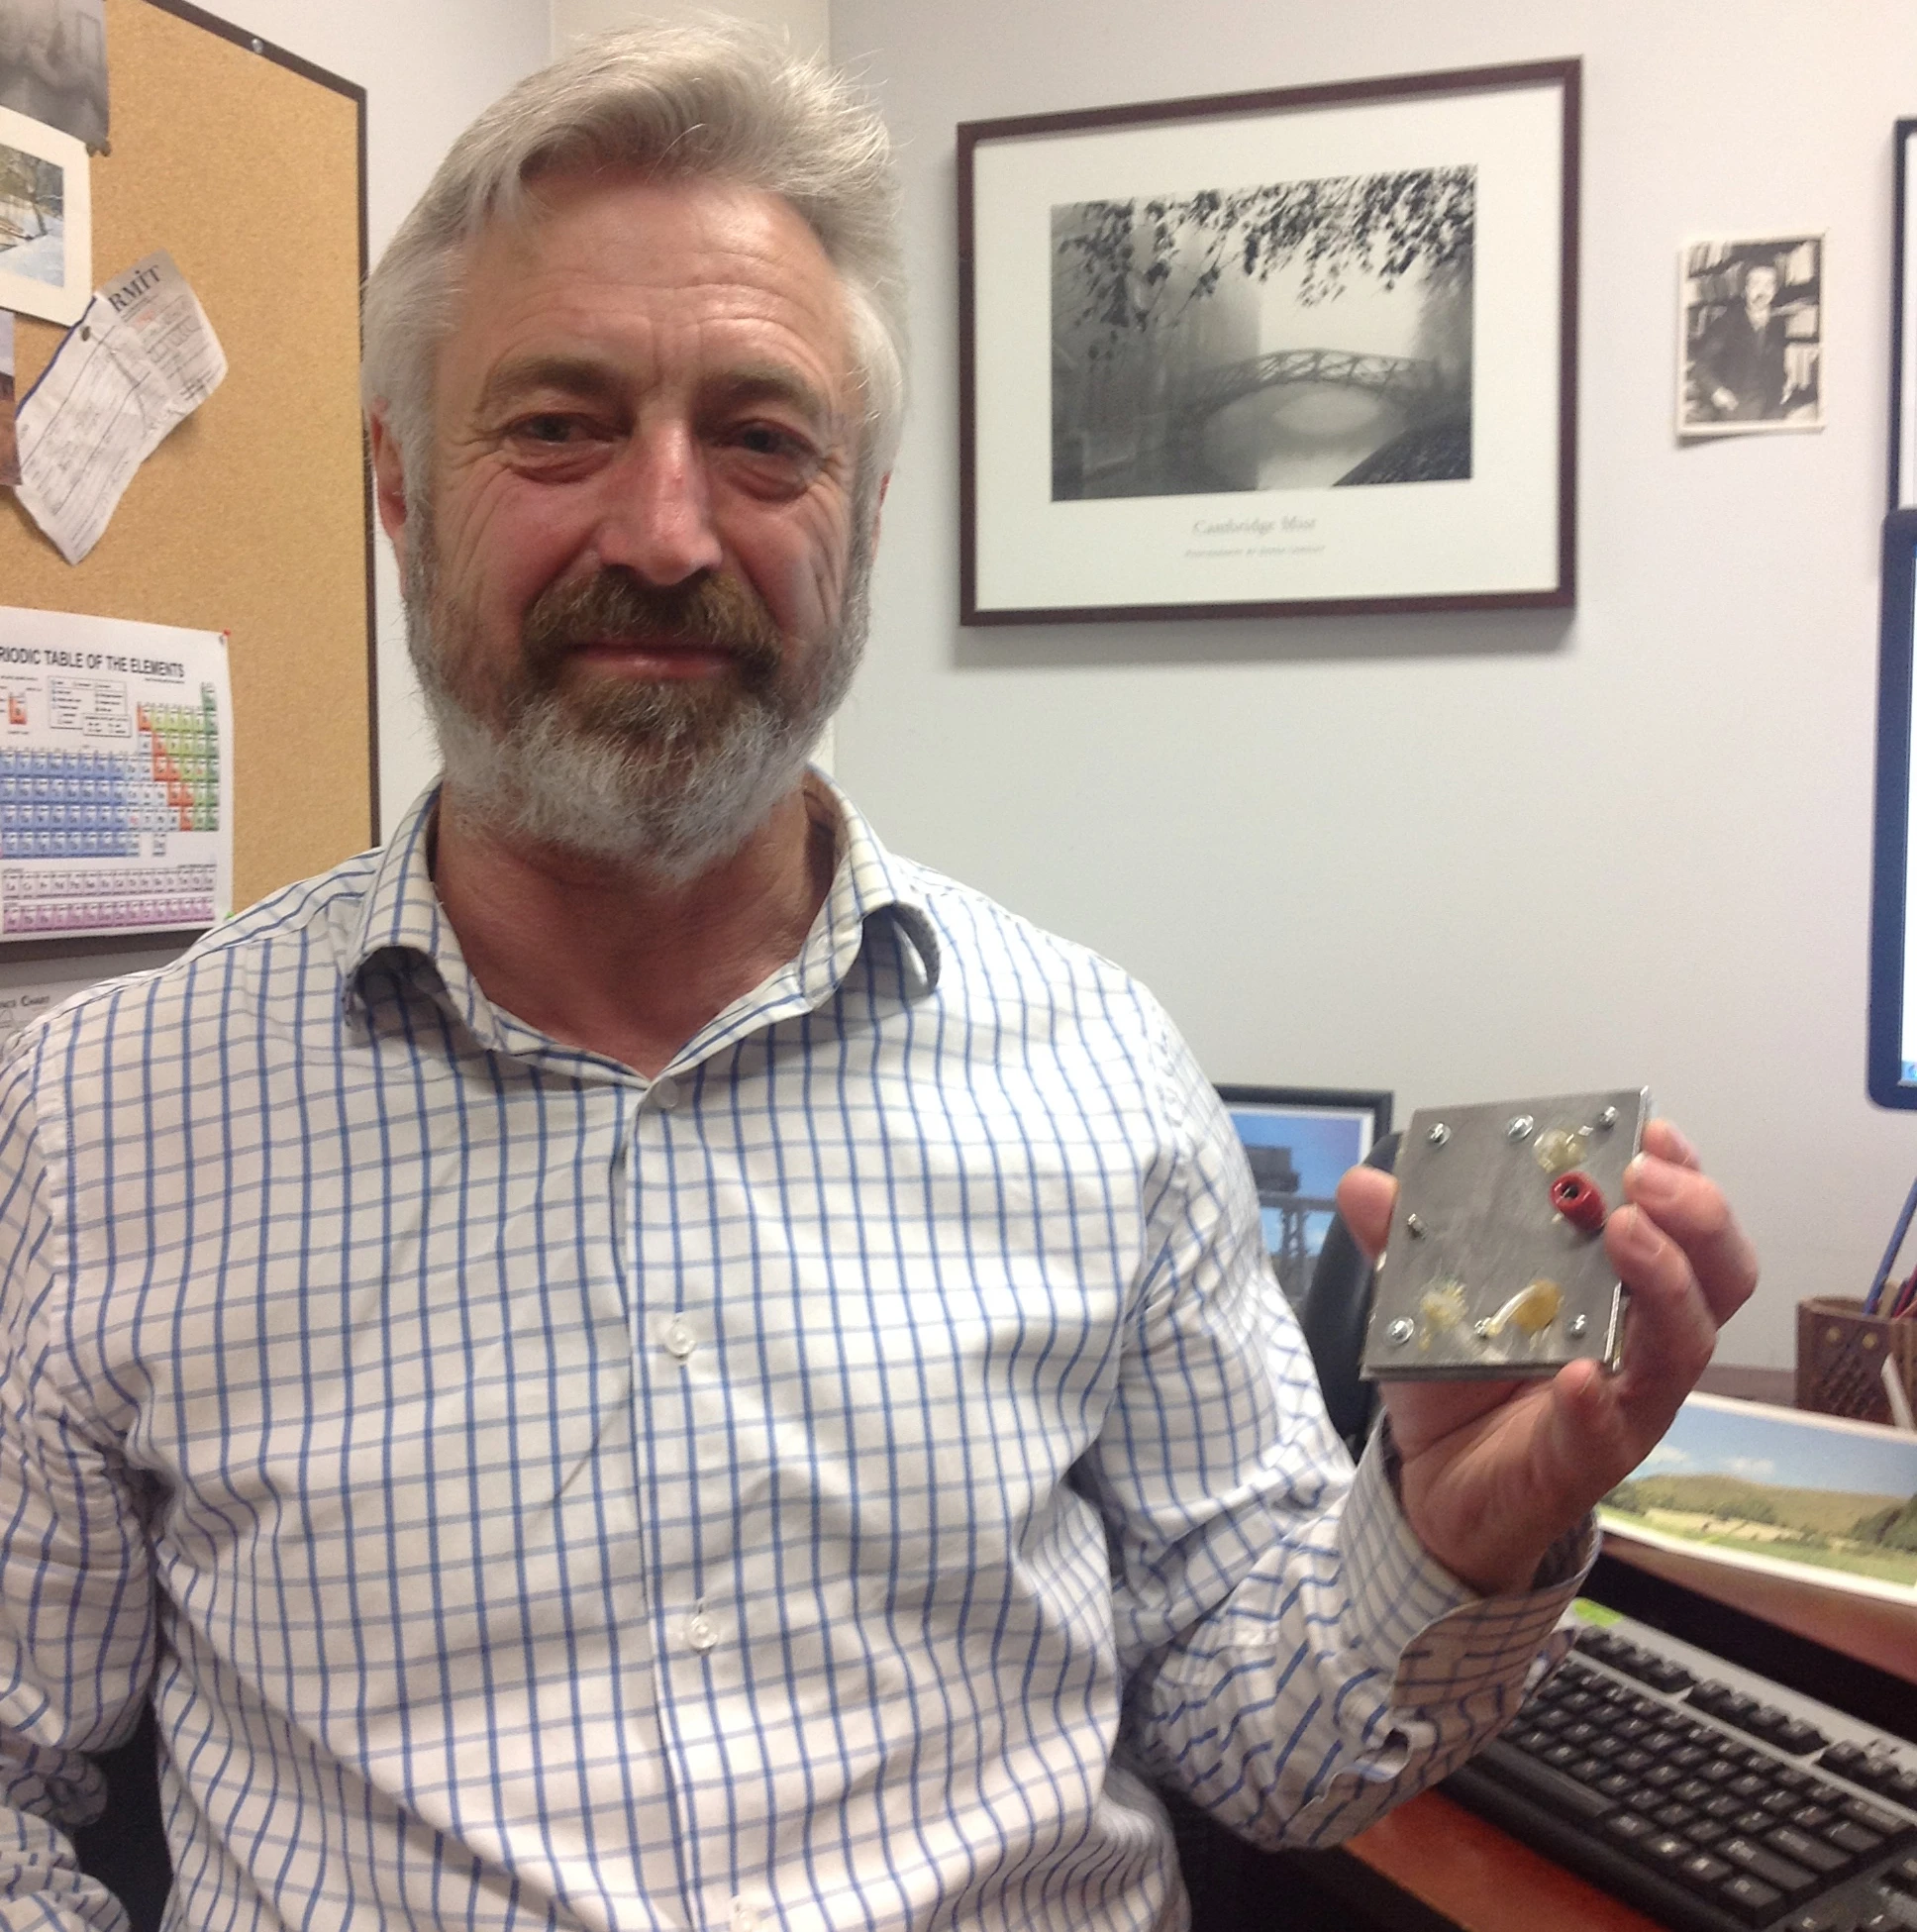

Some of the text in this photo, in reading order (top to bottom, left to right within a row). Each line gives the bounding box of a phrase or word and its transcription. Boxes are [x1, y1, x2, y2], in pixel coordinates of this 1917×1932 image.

[1191, 518, 1275, 537] Cambridge
[45, 650, 83, 668] TABLE
[87, 654, 102, 668] OF
[106, 656, 128, 672] THE
[131, 658, 185, 677] ELEMENTS
